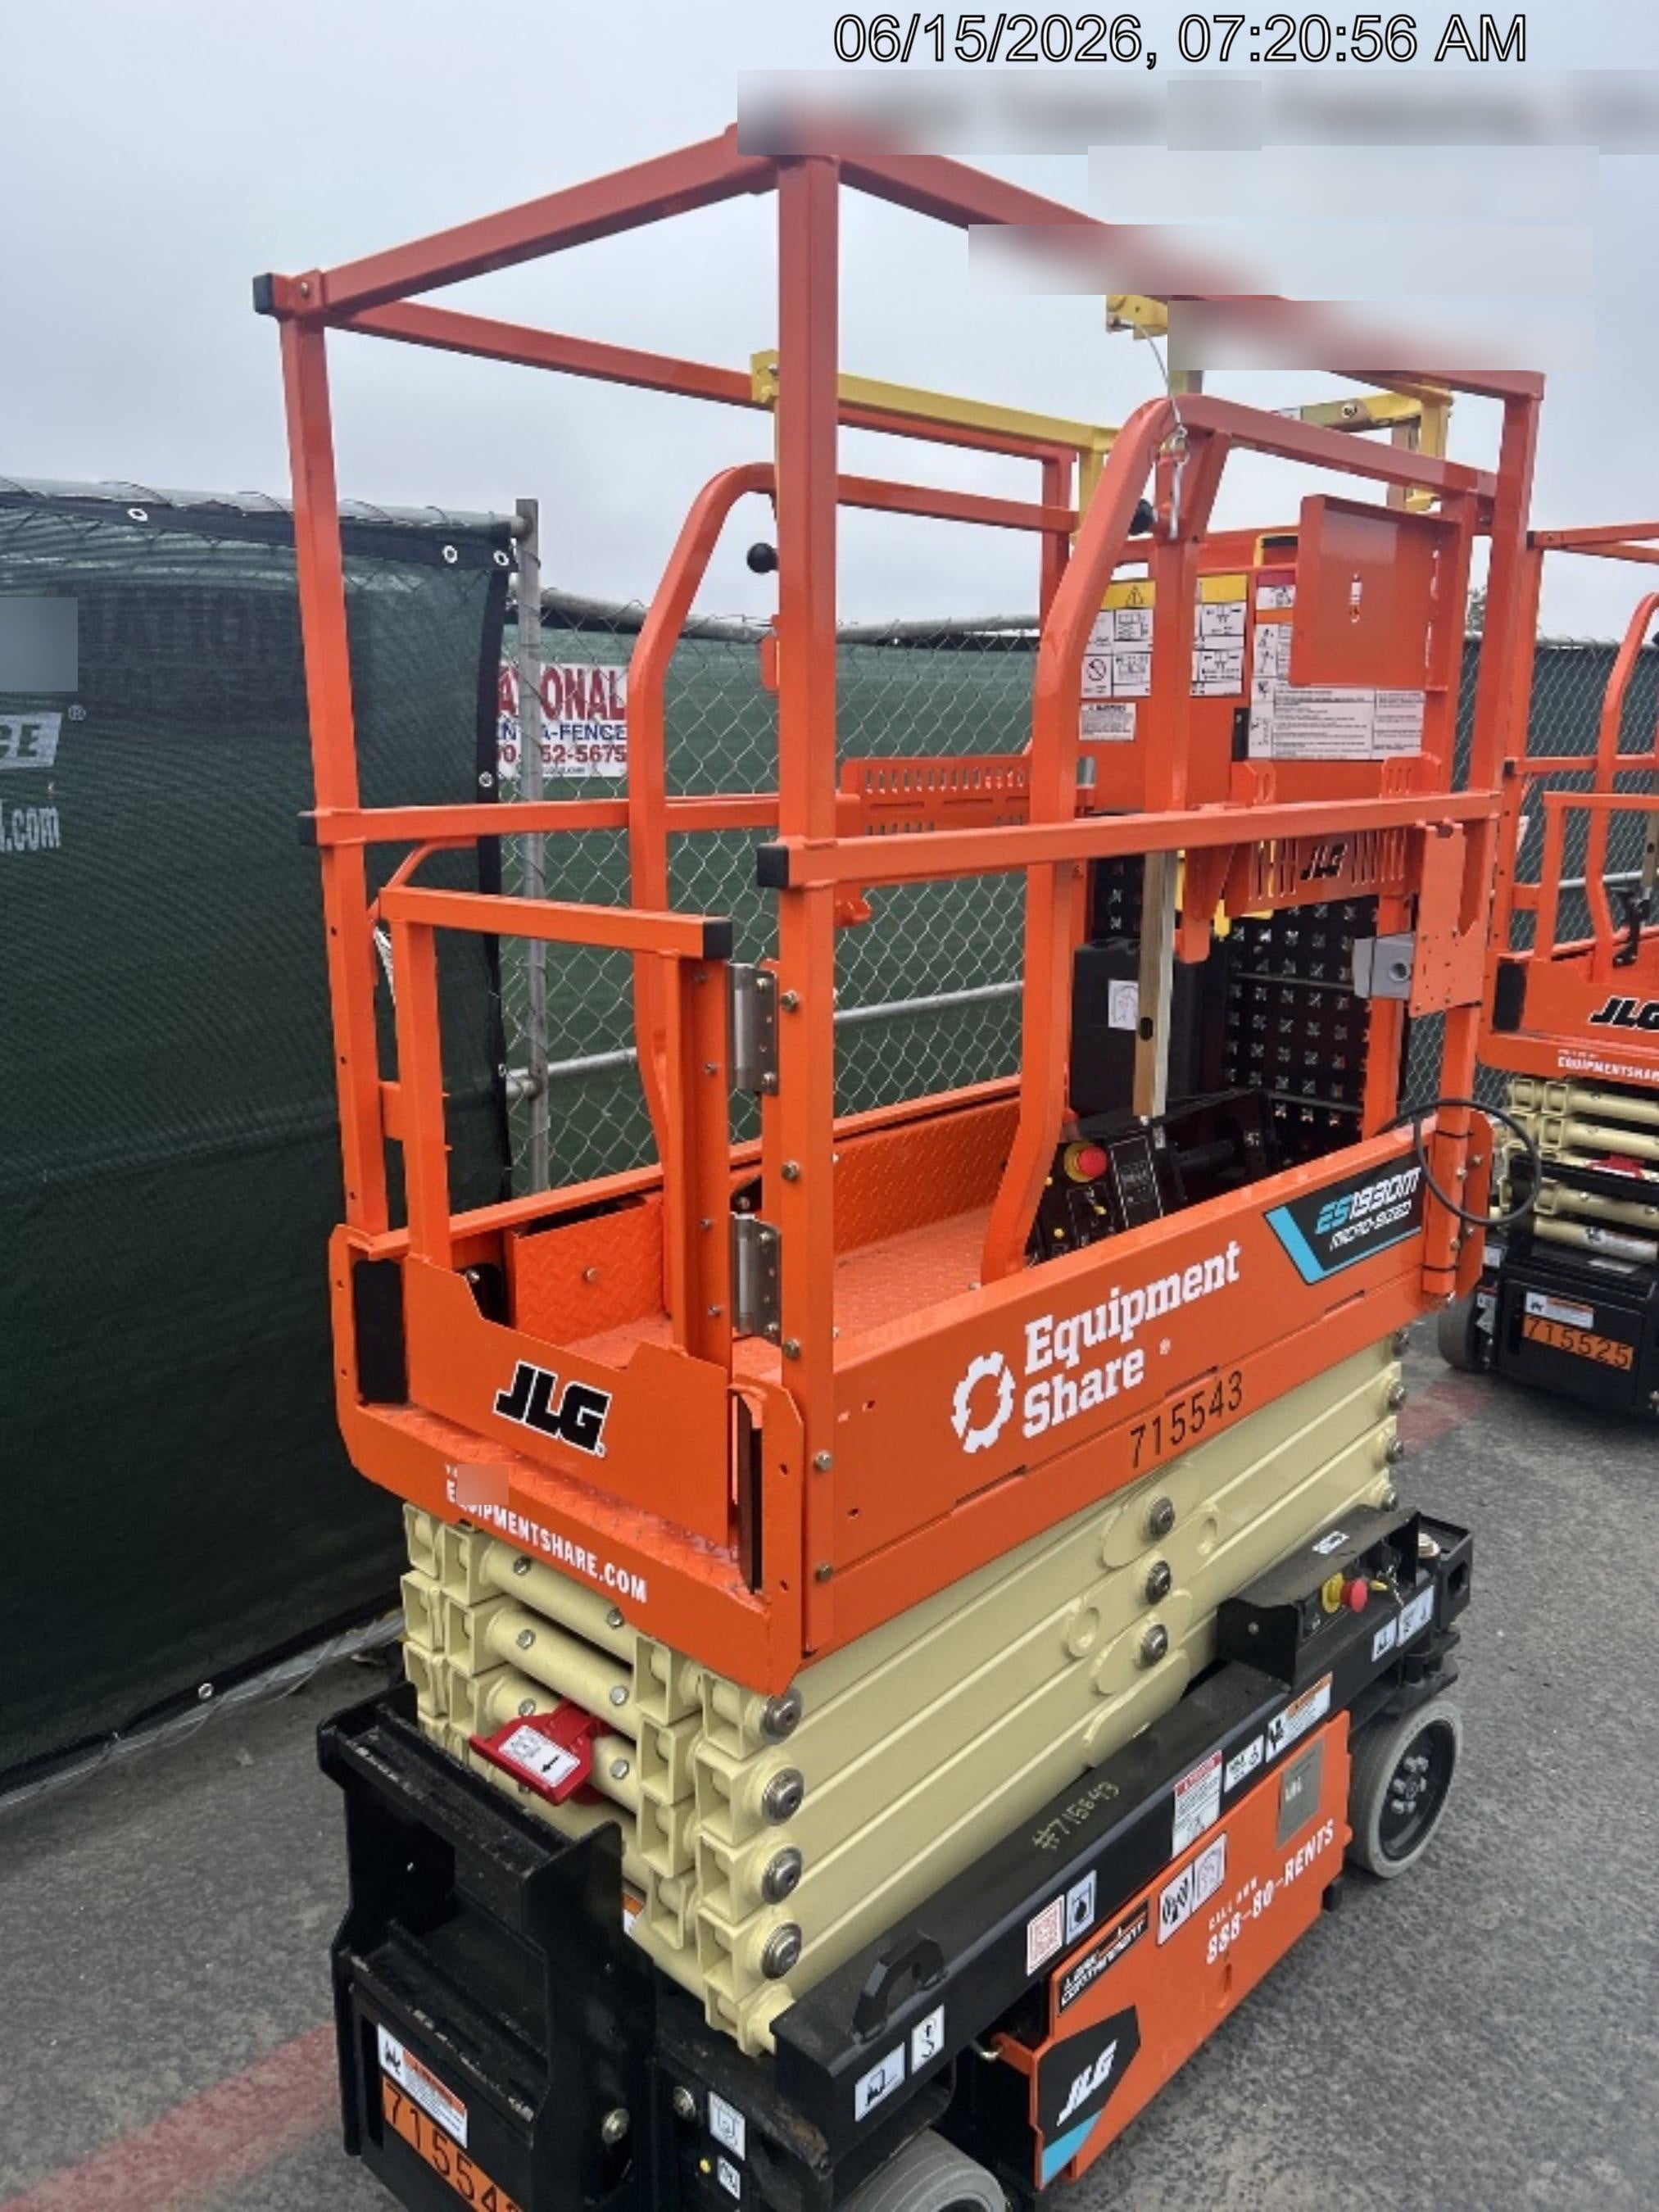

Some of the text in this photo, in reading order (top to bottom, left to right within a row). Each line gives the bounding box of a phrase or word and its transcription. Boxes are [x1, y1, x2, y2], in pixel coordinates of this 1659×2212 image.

[1025, 1240, 1242, 1376] Equipment
[1529, 1317, 1629, 1367] 715525
[493, 1358, 613, 1458] JLG
[1022, 1348, 1145, 1439] Share
[1130, 1370, 1243, 1469] 715543
[446, 1479, 648, 1603] EIPMENTSHARE.COM
[1206, 1817, 1335, 1965] 888-80-RENTS
[1056, 2037, 1117, 2128] JLG
